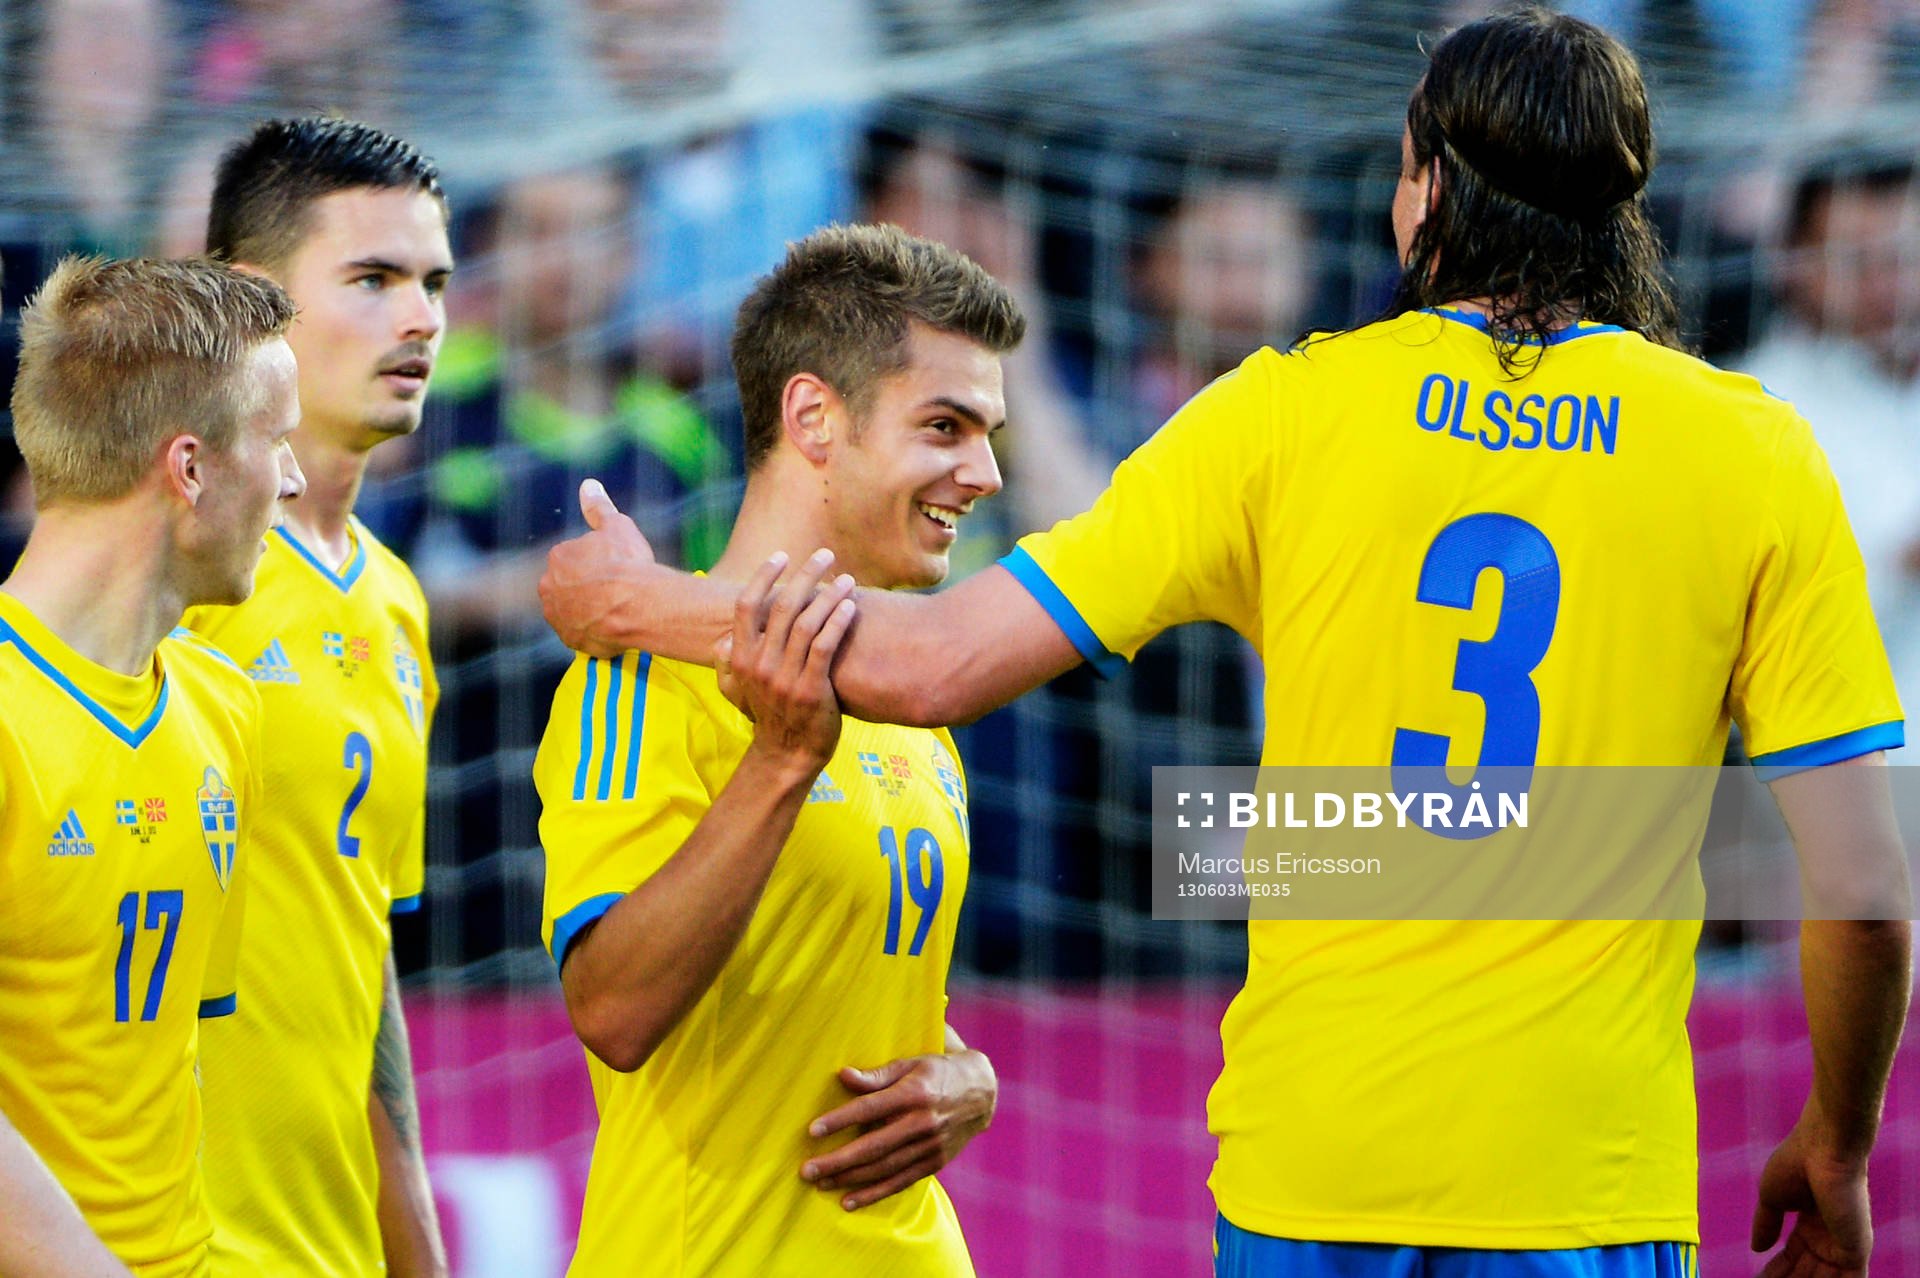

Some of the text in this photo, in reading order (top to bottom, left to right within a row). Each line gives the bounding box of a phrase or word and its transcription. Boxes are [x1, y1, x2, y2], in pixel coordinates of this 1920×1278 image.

[1416, 373, 1621, 455] OLSSON
[1390, 511, 1561, 841] 3
[47, 839, 96, 857] adidas
[337, 731, 373, 859] 2
[114, 889, 184, 1023] 17
[878, 825, 944, 957] 19
